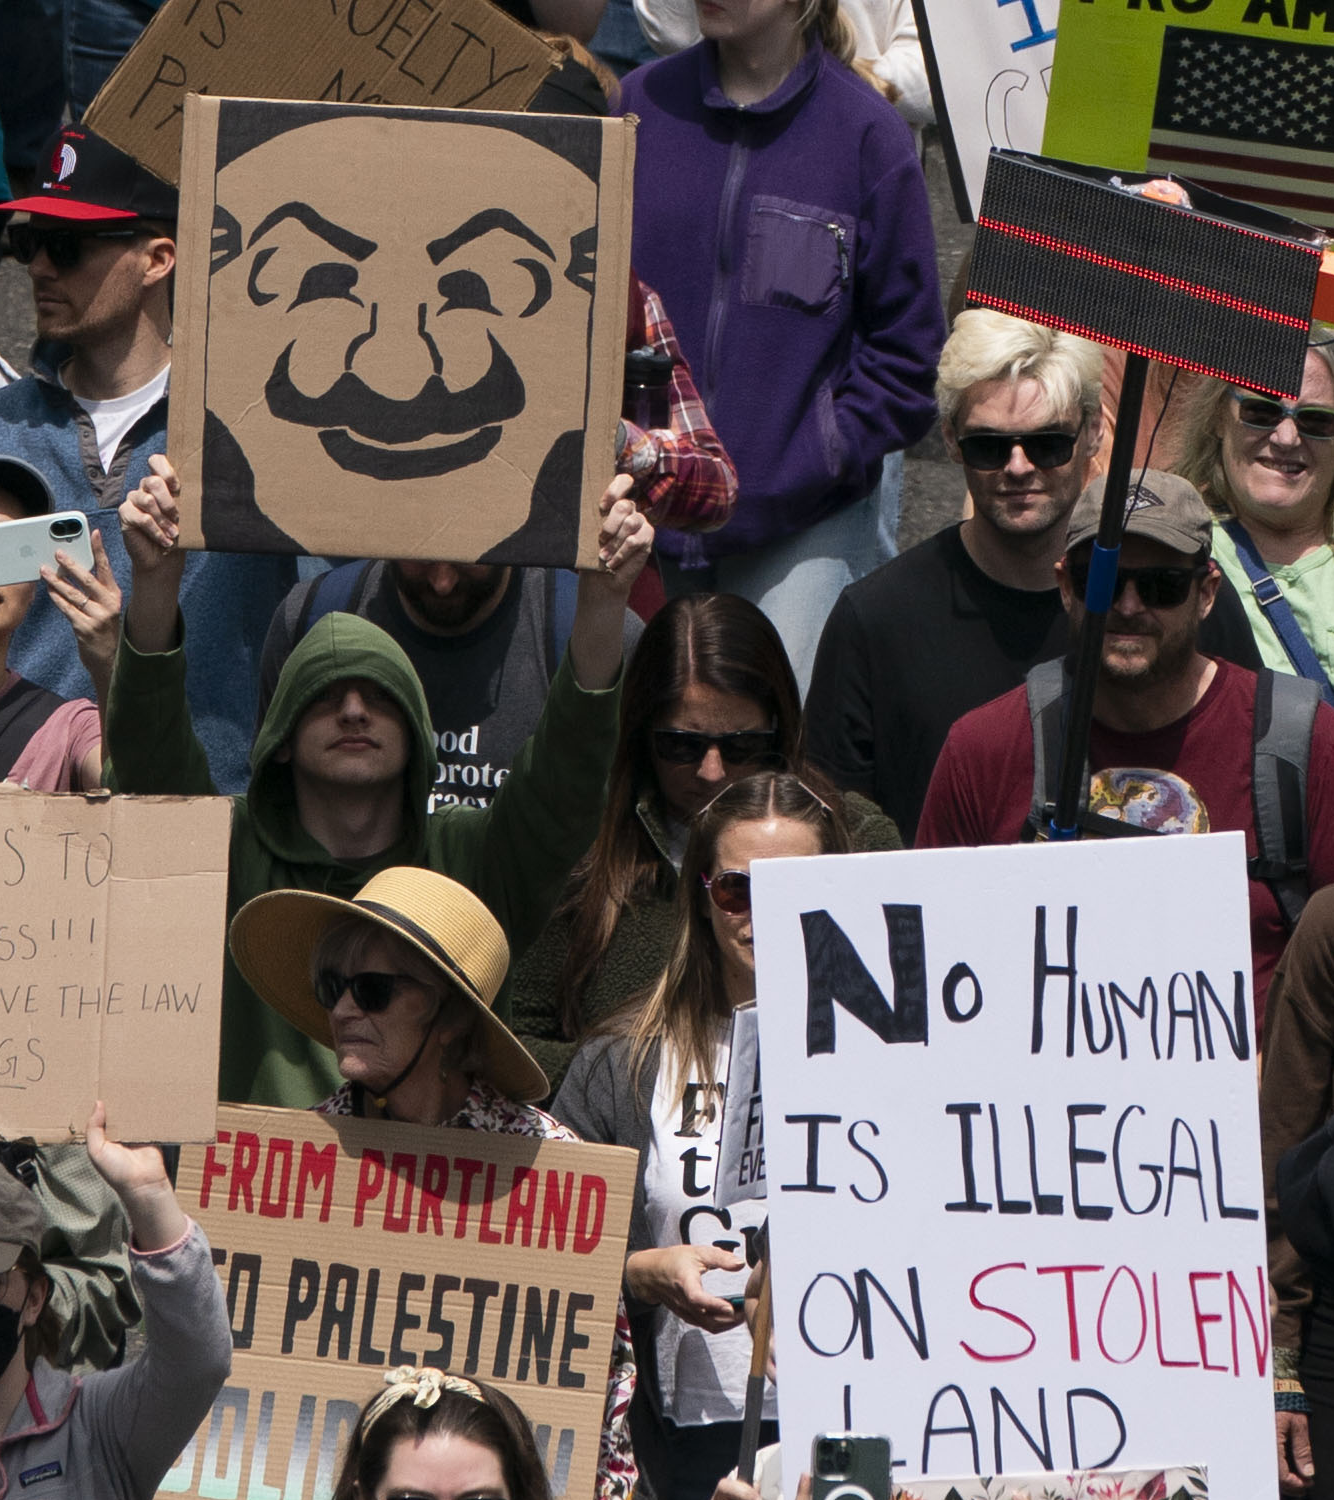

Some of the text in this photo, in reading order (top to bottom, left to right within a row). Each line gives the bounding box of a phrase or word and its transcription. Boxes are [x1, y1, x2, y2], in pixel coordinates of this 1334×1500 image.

[55, 981, 125, 1018] THE
[139, 981, 203, 1017] LAW
[779, 1112, 890, 1204] IS
[943, 1101, 1260, 1221] ILLEGAL
[279, 1256, 596, 1389] PALESTINE
[798, 1259, 1270, 1378] ON STOLEN
